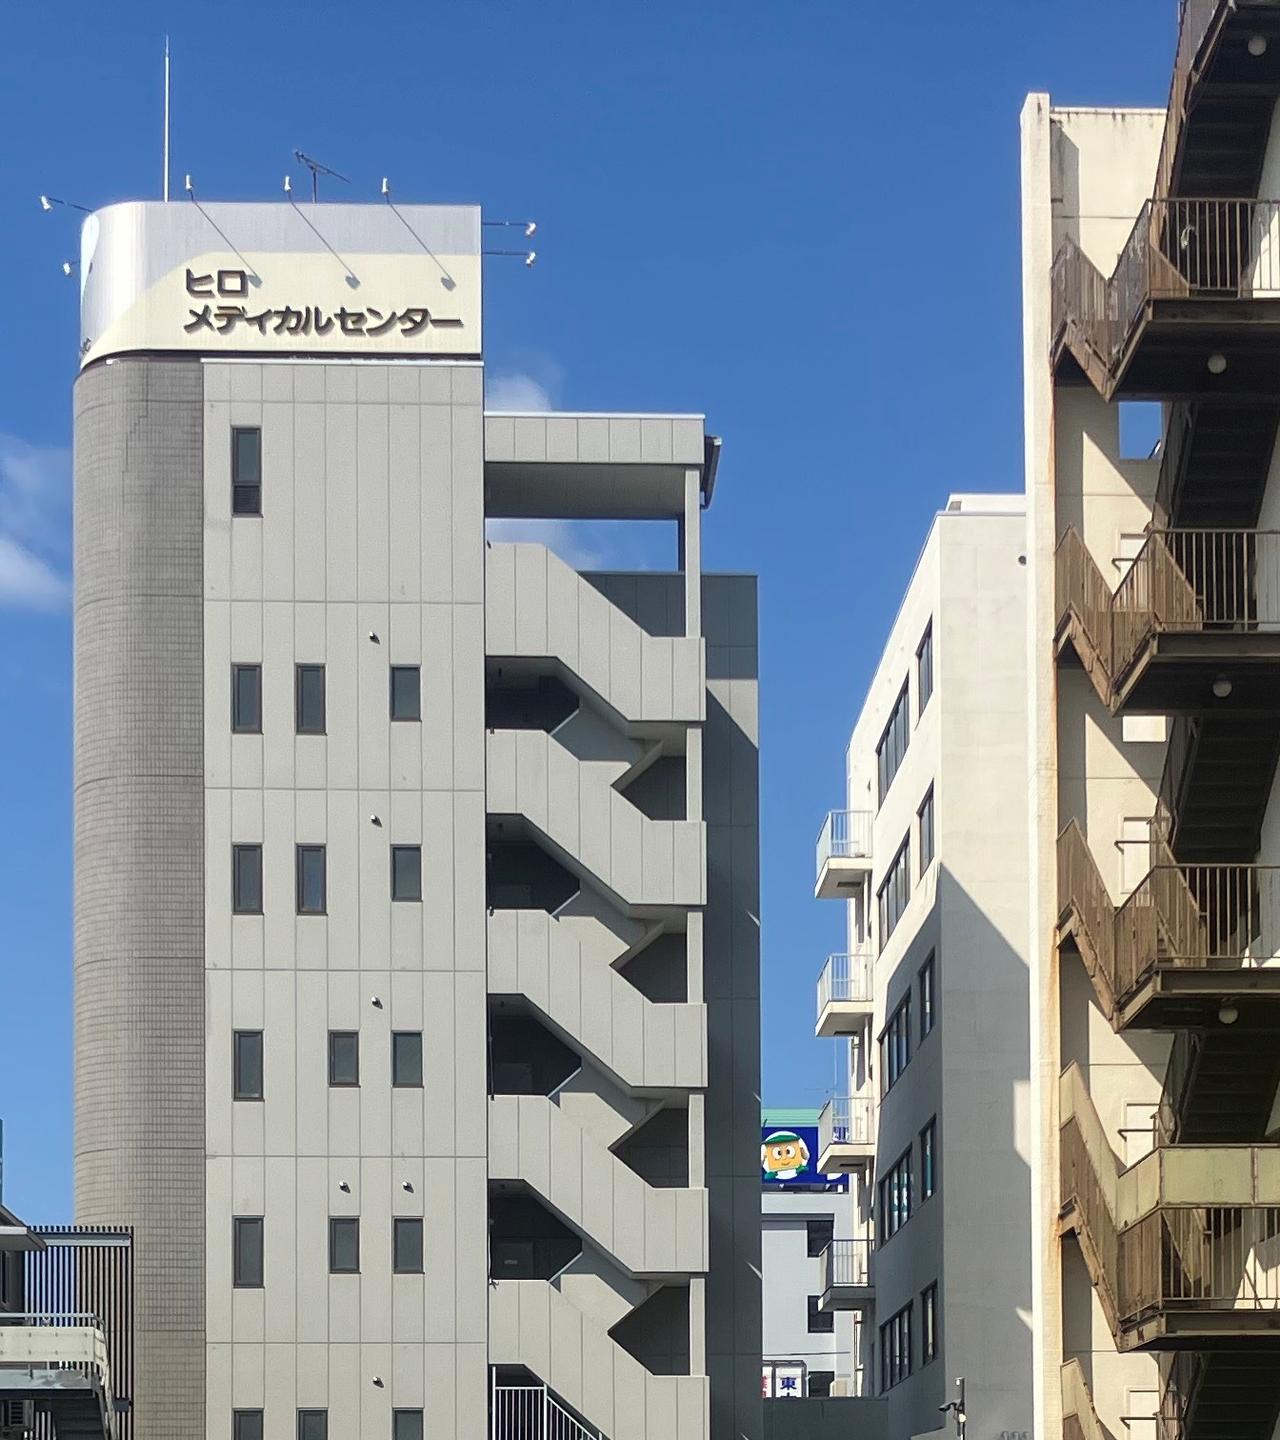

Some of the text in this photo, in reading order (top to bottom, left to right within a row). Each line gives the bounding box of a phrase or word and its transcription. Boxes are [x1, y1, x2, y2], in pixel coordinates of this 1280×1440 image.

[185, 267, 248, 297] ヒロ
[184, 304, 464, 337] メディカルセンター
